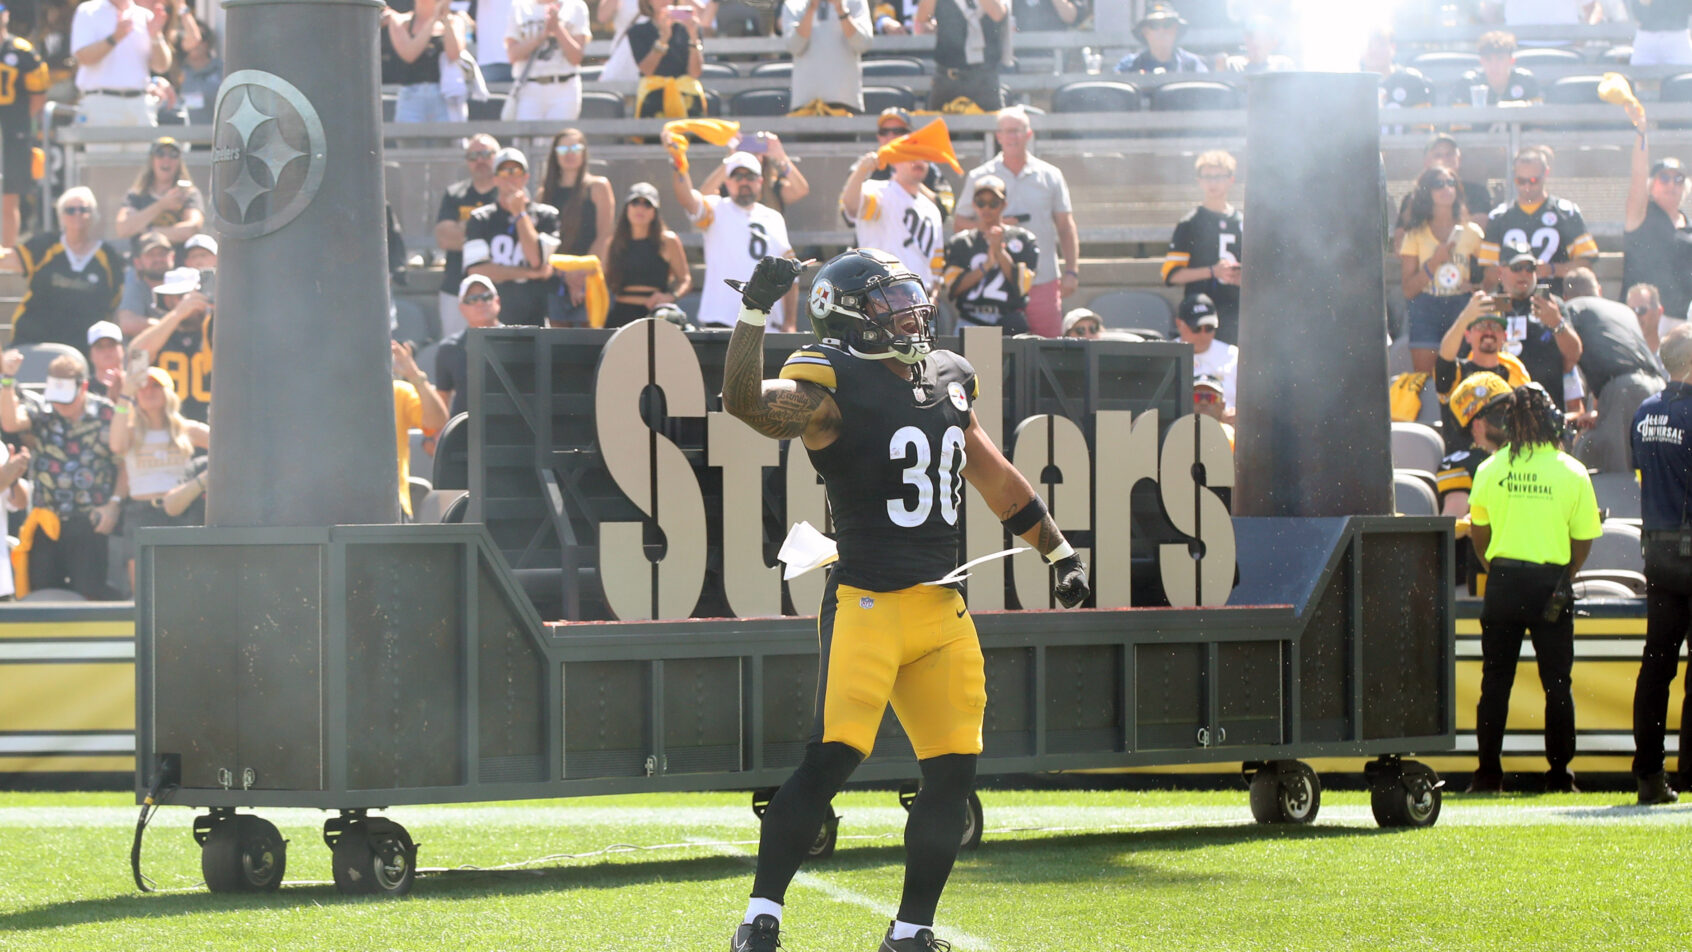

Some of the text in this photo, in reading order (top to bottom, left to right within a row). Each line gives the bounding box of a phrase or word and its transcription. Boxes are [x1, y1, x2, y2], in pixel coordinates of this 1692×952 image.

[1218, 232, 1237, 268] 5
[595, 317, 1236, 622] Stlers
[886, 425, 967, 528] 30
[1507, 470, 1538, 482] ALLIED
[1507, 482, 1553, 495] UNIVERSAL
